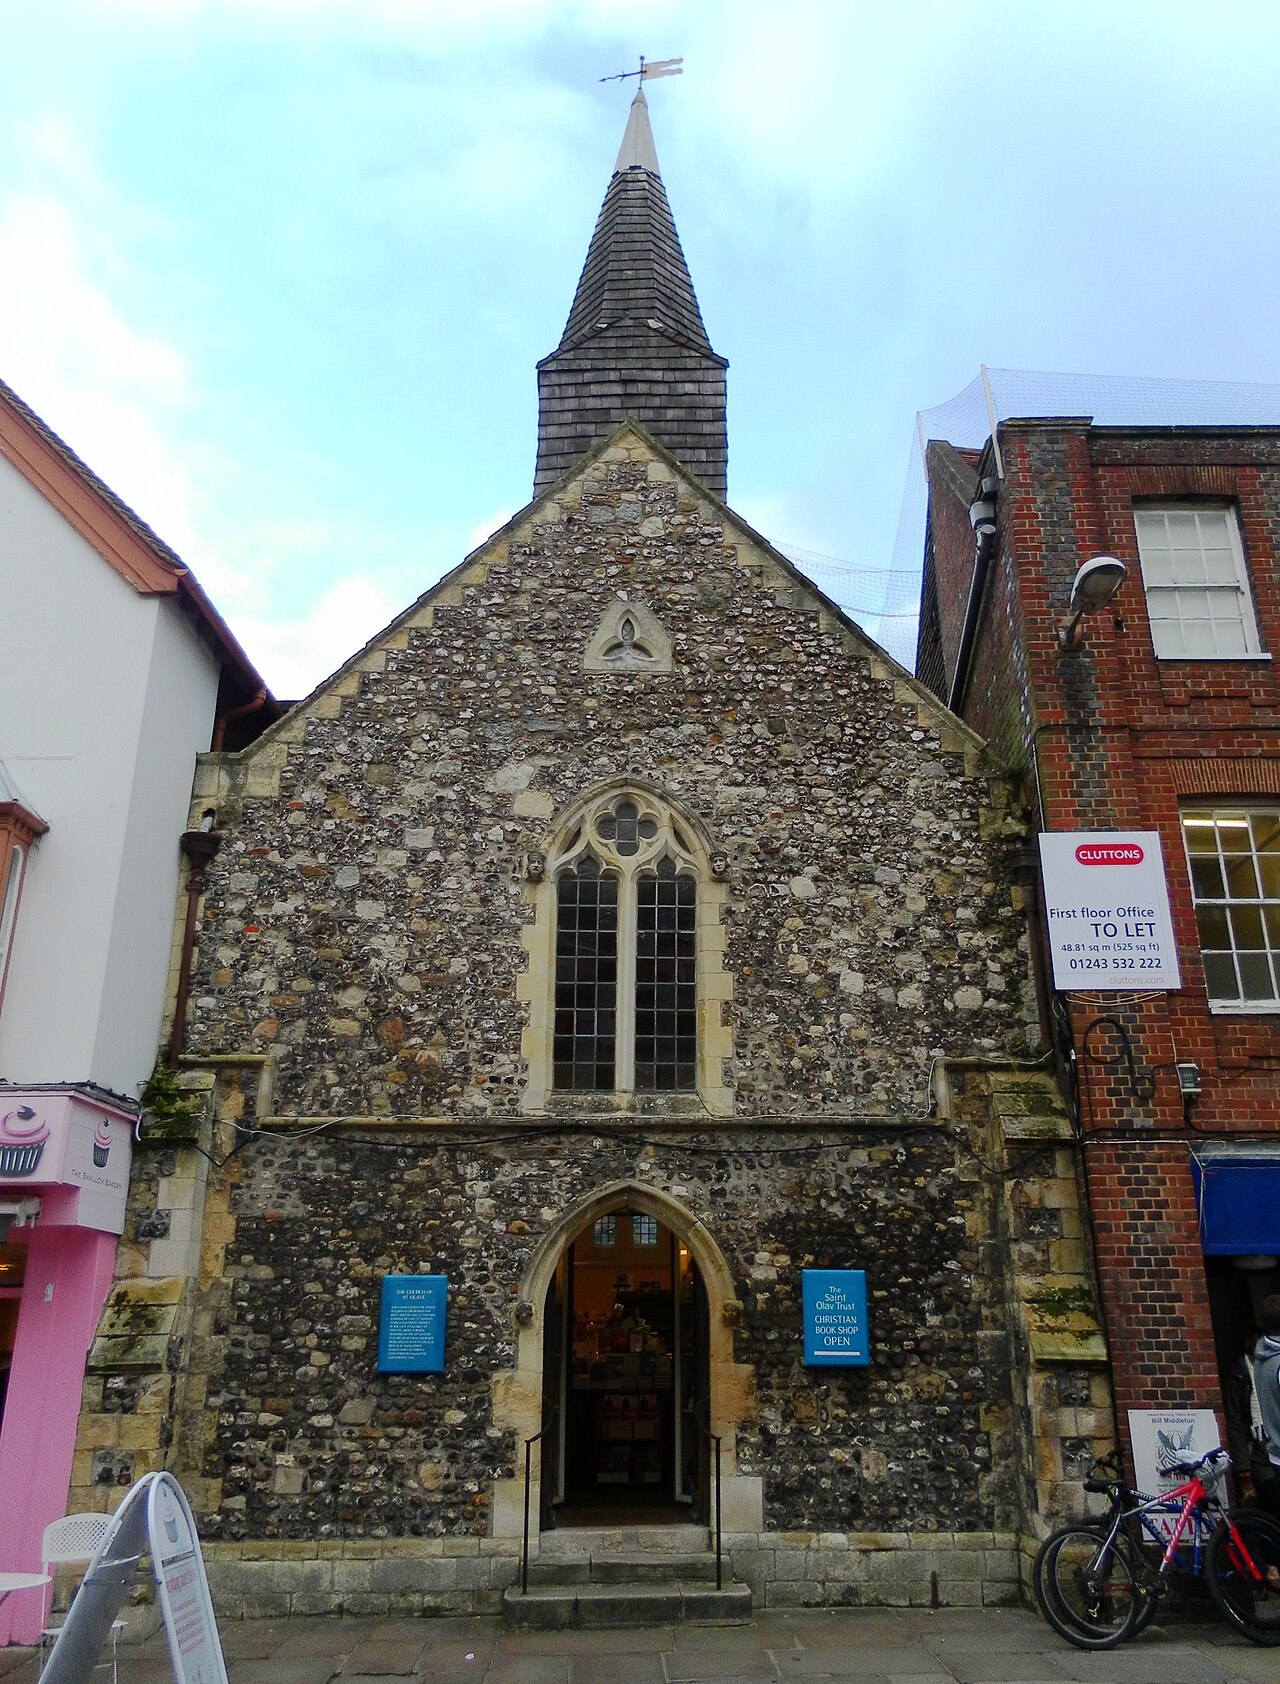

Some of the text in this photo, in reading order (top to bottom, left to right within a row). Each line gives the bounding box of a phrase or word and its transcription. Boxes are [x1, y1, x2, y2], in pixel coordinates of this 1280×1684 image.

[1078, 849, 1140, 860] CLUTTONS
[1050, 906, 1154, 919] First floor Office
[1090, 922, 1156, 938] TO LET
[1061, 943, 1085, 952] 48.81
[1088, 945, 1099, 953] sq
[1113, 943, 1133, 952] (525
[1135, 944, 1146, 953] sq
[1149, 942, 1160, 952] ft)
[1069, 957, 1162, 970] 01243 532 222
[1109, 976, 1165, 985] cluttons.com
[824, 1293, 846, 1301] Saint
[816, 1301, 855, 1310] Olav Trust
[814, 1315, 857, 1324] CHRISTIAN
[815, 1326, 858, 1335] BOOK SHOP
[823, 1336, 850, 1346] OPEN
